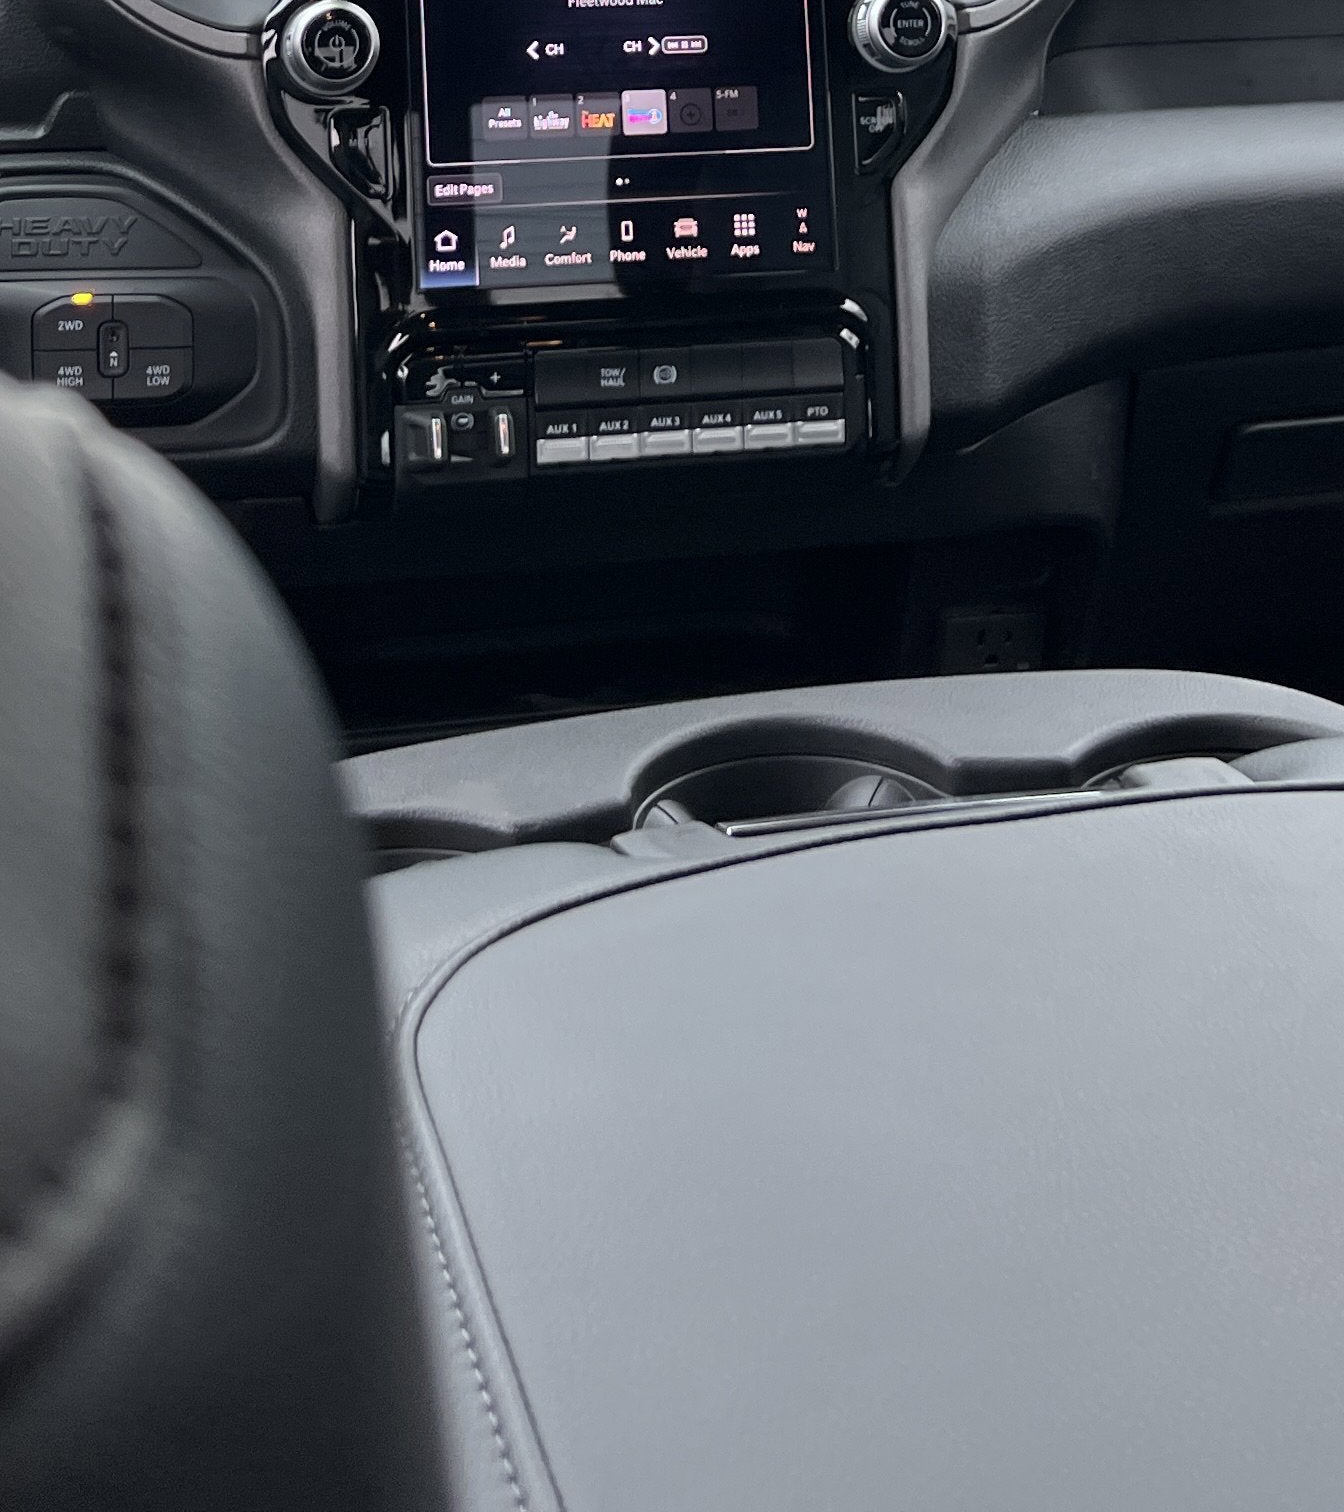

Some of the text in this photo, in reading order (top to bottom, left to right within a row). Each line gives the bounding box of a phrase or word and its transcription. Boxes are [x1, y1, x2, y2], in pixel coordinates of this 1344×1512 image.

[896, 19, 925, 29] ENTER
[545, 43, 565, 56] CH
[623, 40, 643, 53] CH
[578, 95, 584, 105] 2
[669, 91, 677, 101] 4
[497, 107, 512, 117] All
[488, 117, 523, 129] Presets
[581, 113, 616, 128] HEAT
[434, 182, 495, 197] Edit Pages
[796, 207, 808, 218] W
[10, 237, 130, 258] DUTY
[666, 245, 708, 260] Vehicle
[730, 243, 760, 258] Apps
[792, 240, 816, 254] Nav
[544, 252, 592, 266] Comfort
[609, 249, 646, 263] Phone
[429, 258, 466, 273] Home
[490, 255, 527, 269] Media
[57, 320, 84, 331] 2WD
[109, 357, 118, 367] N
[57, 366, 83, 376] 4WD
[145, 364, 171, 375] 4WD
[56, 377, 84, 386] HIGH
[146, 375, 171, 386] LOW
[600, 376, 625, 387] HAUL
[451, 394, 474, 404] GAIN
[753, 411, 774, 421] AUX
[807, 406, 829, 417] PTO
[651, 417, 671, 427] AUX
[702, 414, 722, 424] AUX
[546, 424, 570, 434] AUX
[599, 421, 620, 431] AUX
